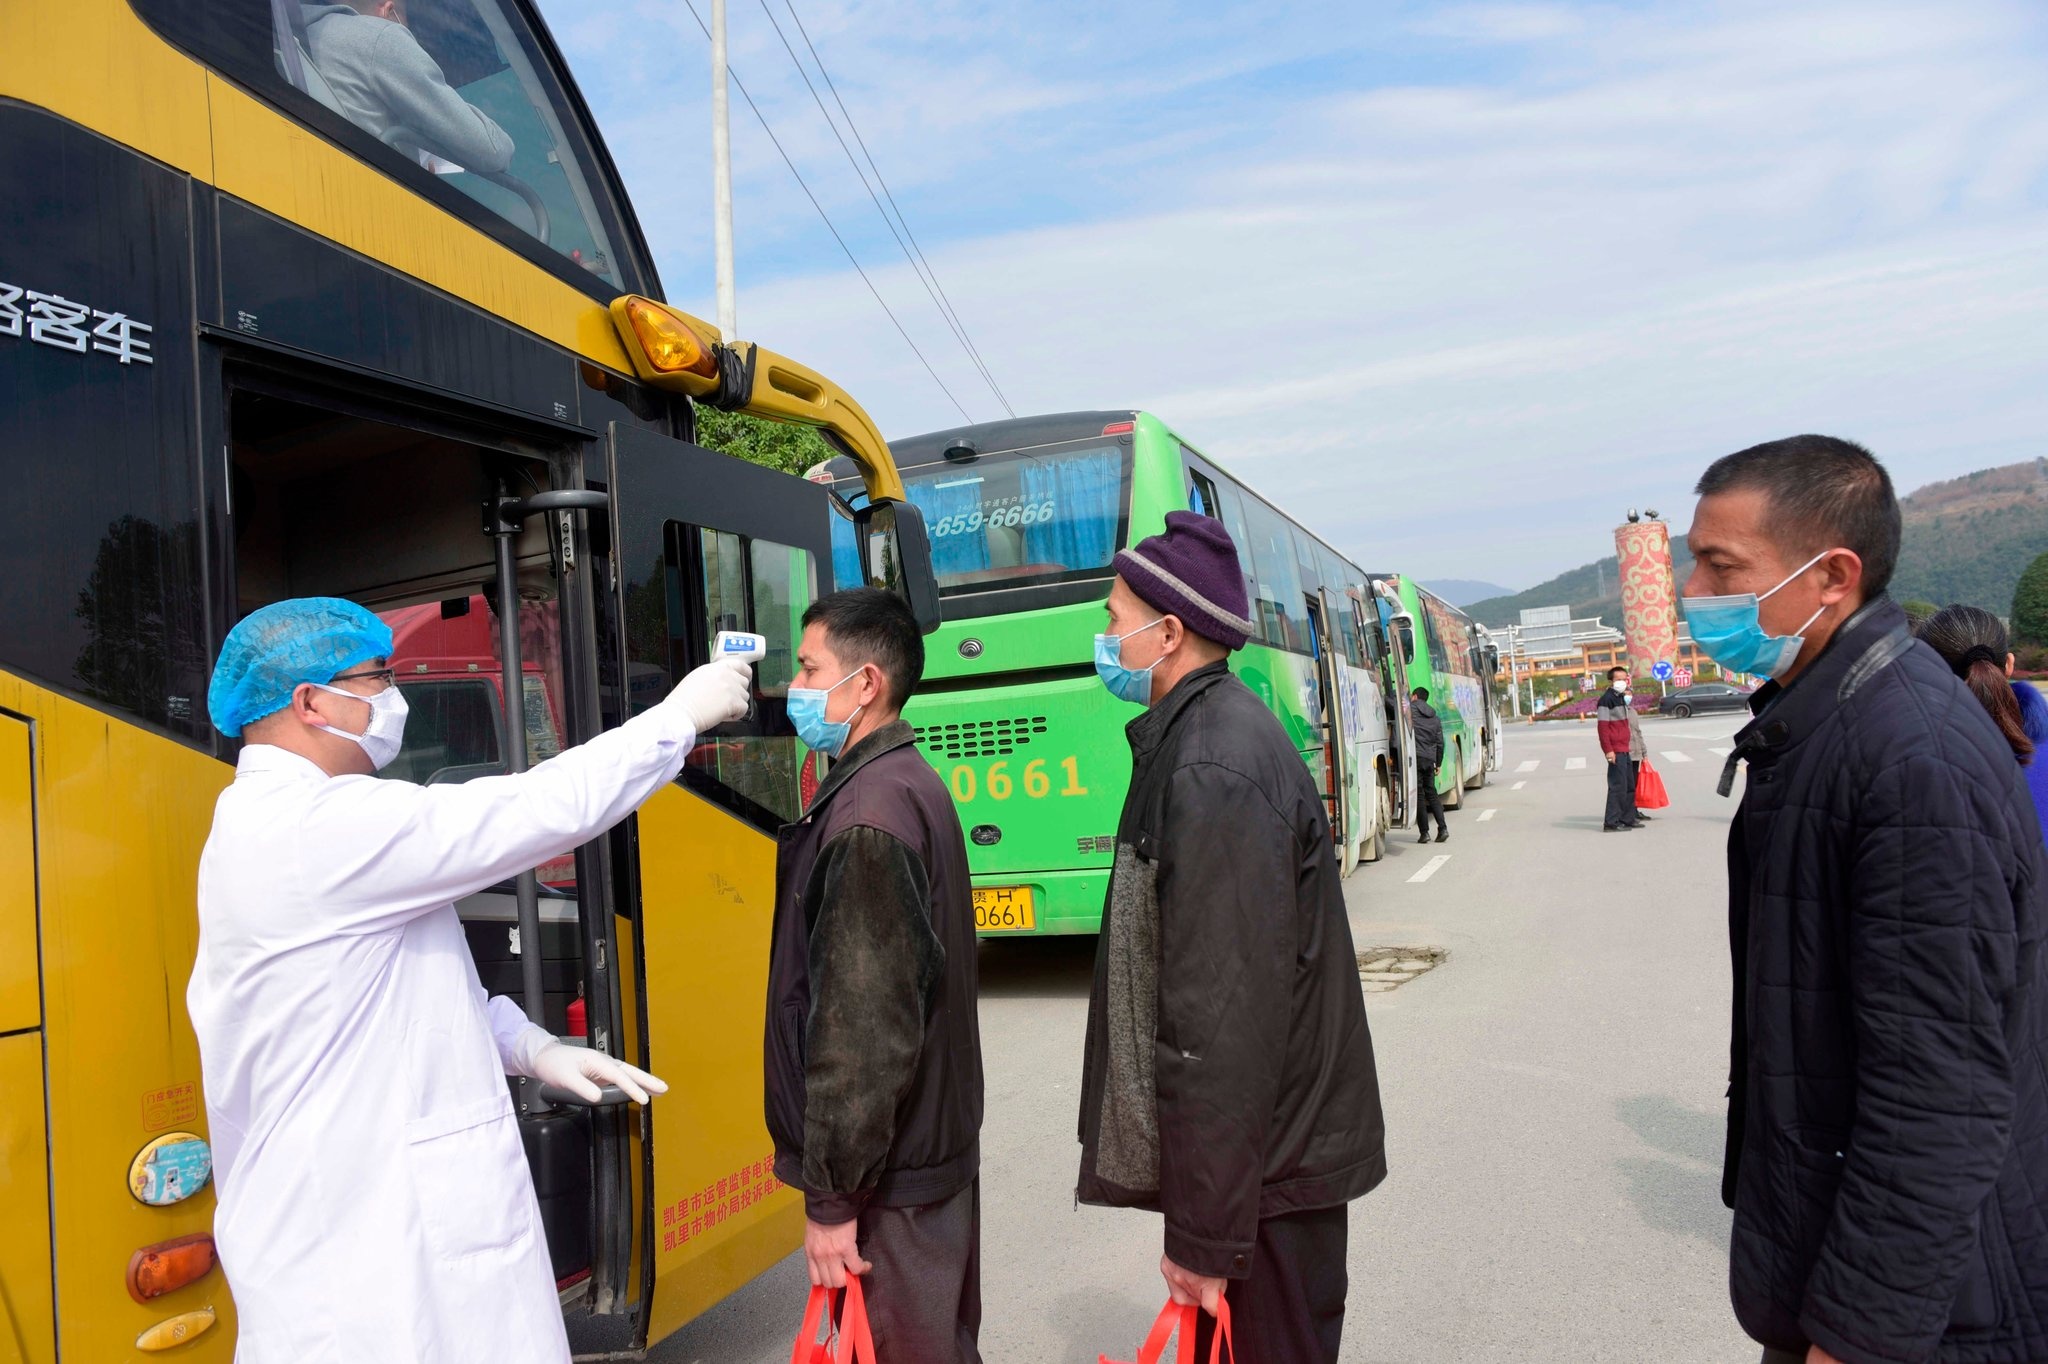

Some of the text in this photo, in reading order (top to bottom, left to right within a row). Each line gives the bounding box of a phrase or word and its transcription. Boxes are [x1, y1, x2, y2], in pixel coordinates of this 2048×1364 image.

[926, 500, 1055, 538] -659-6666
[934, 755, 1089, 803] 0661
[663, 1153, 775, 1228] 凯里市运管监督电话
